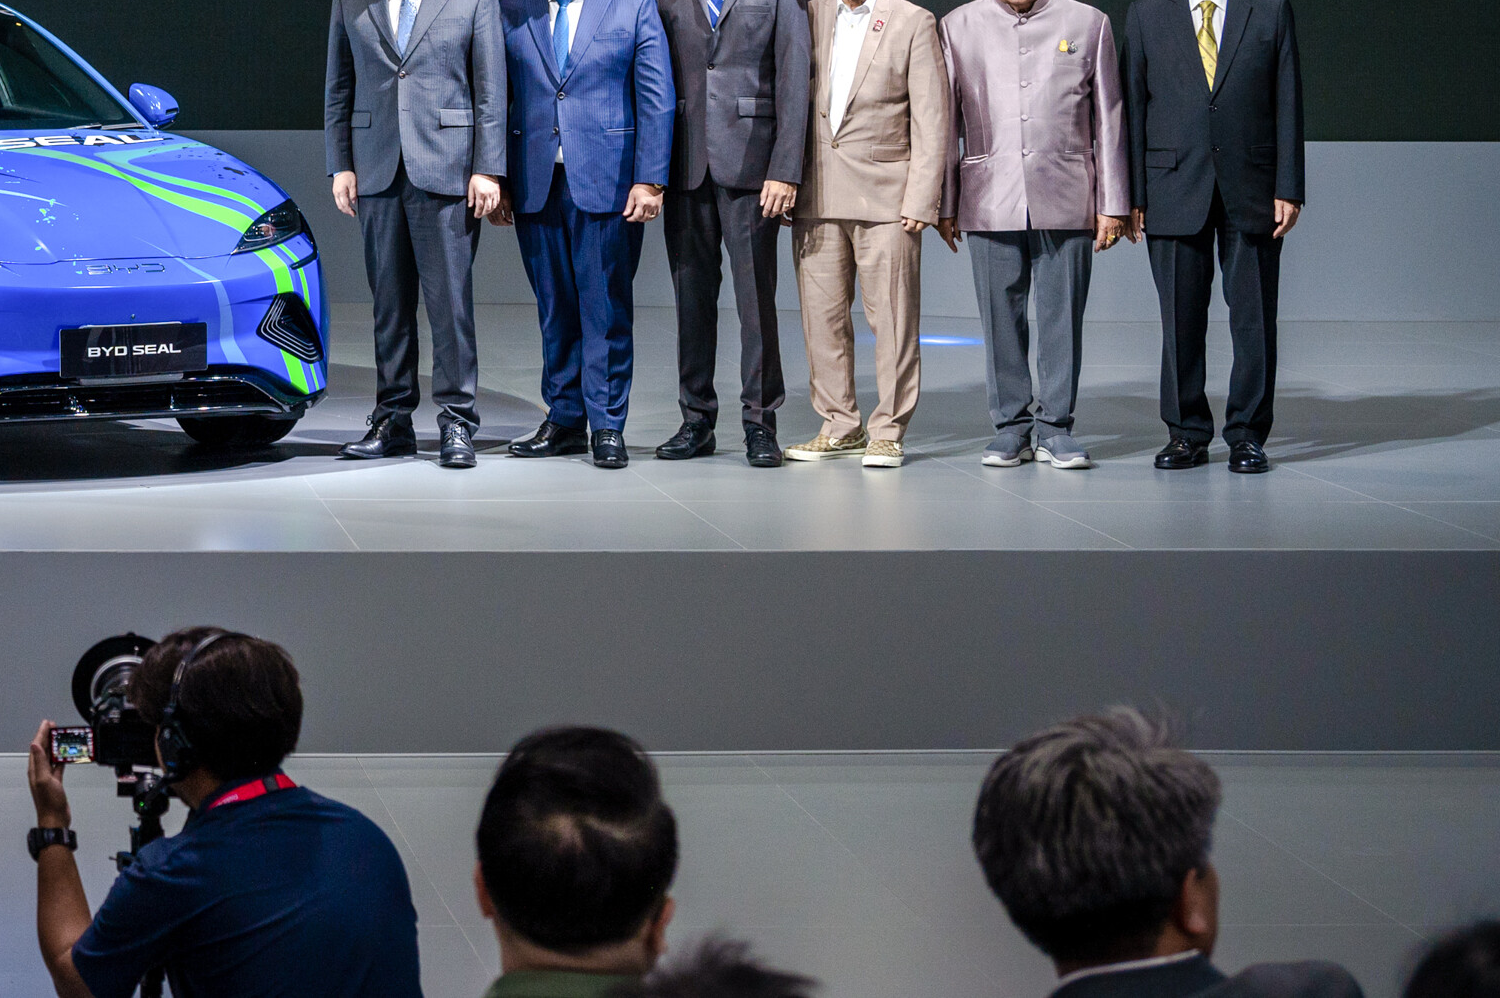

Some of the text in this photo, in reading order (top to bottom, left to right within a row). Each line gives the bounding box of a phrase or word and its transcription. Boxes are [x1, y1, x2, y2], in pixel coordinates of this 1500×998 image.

[85, 262, 165, 275] BYD
[87, 343, 182, 358] BYD SEAL
